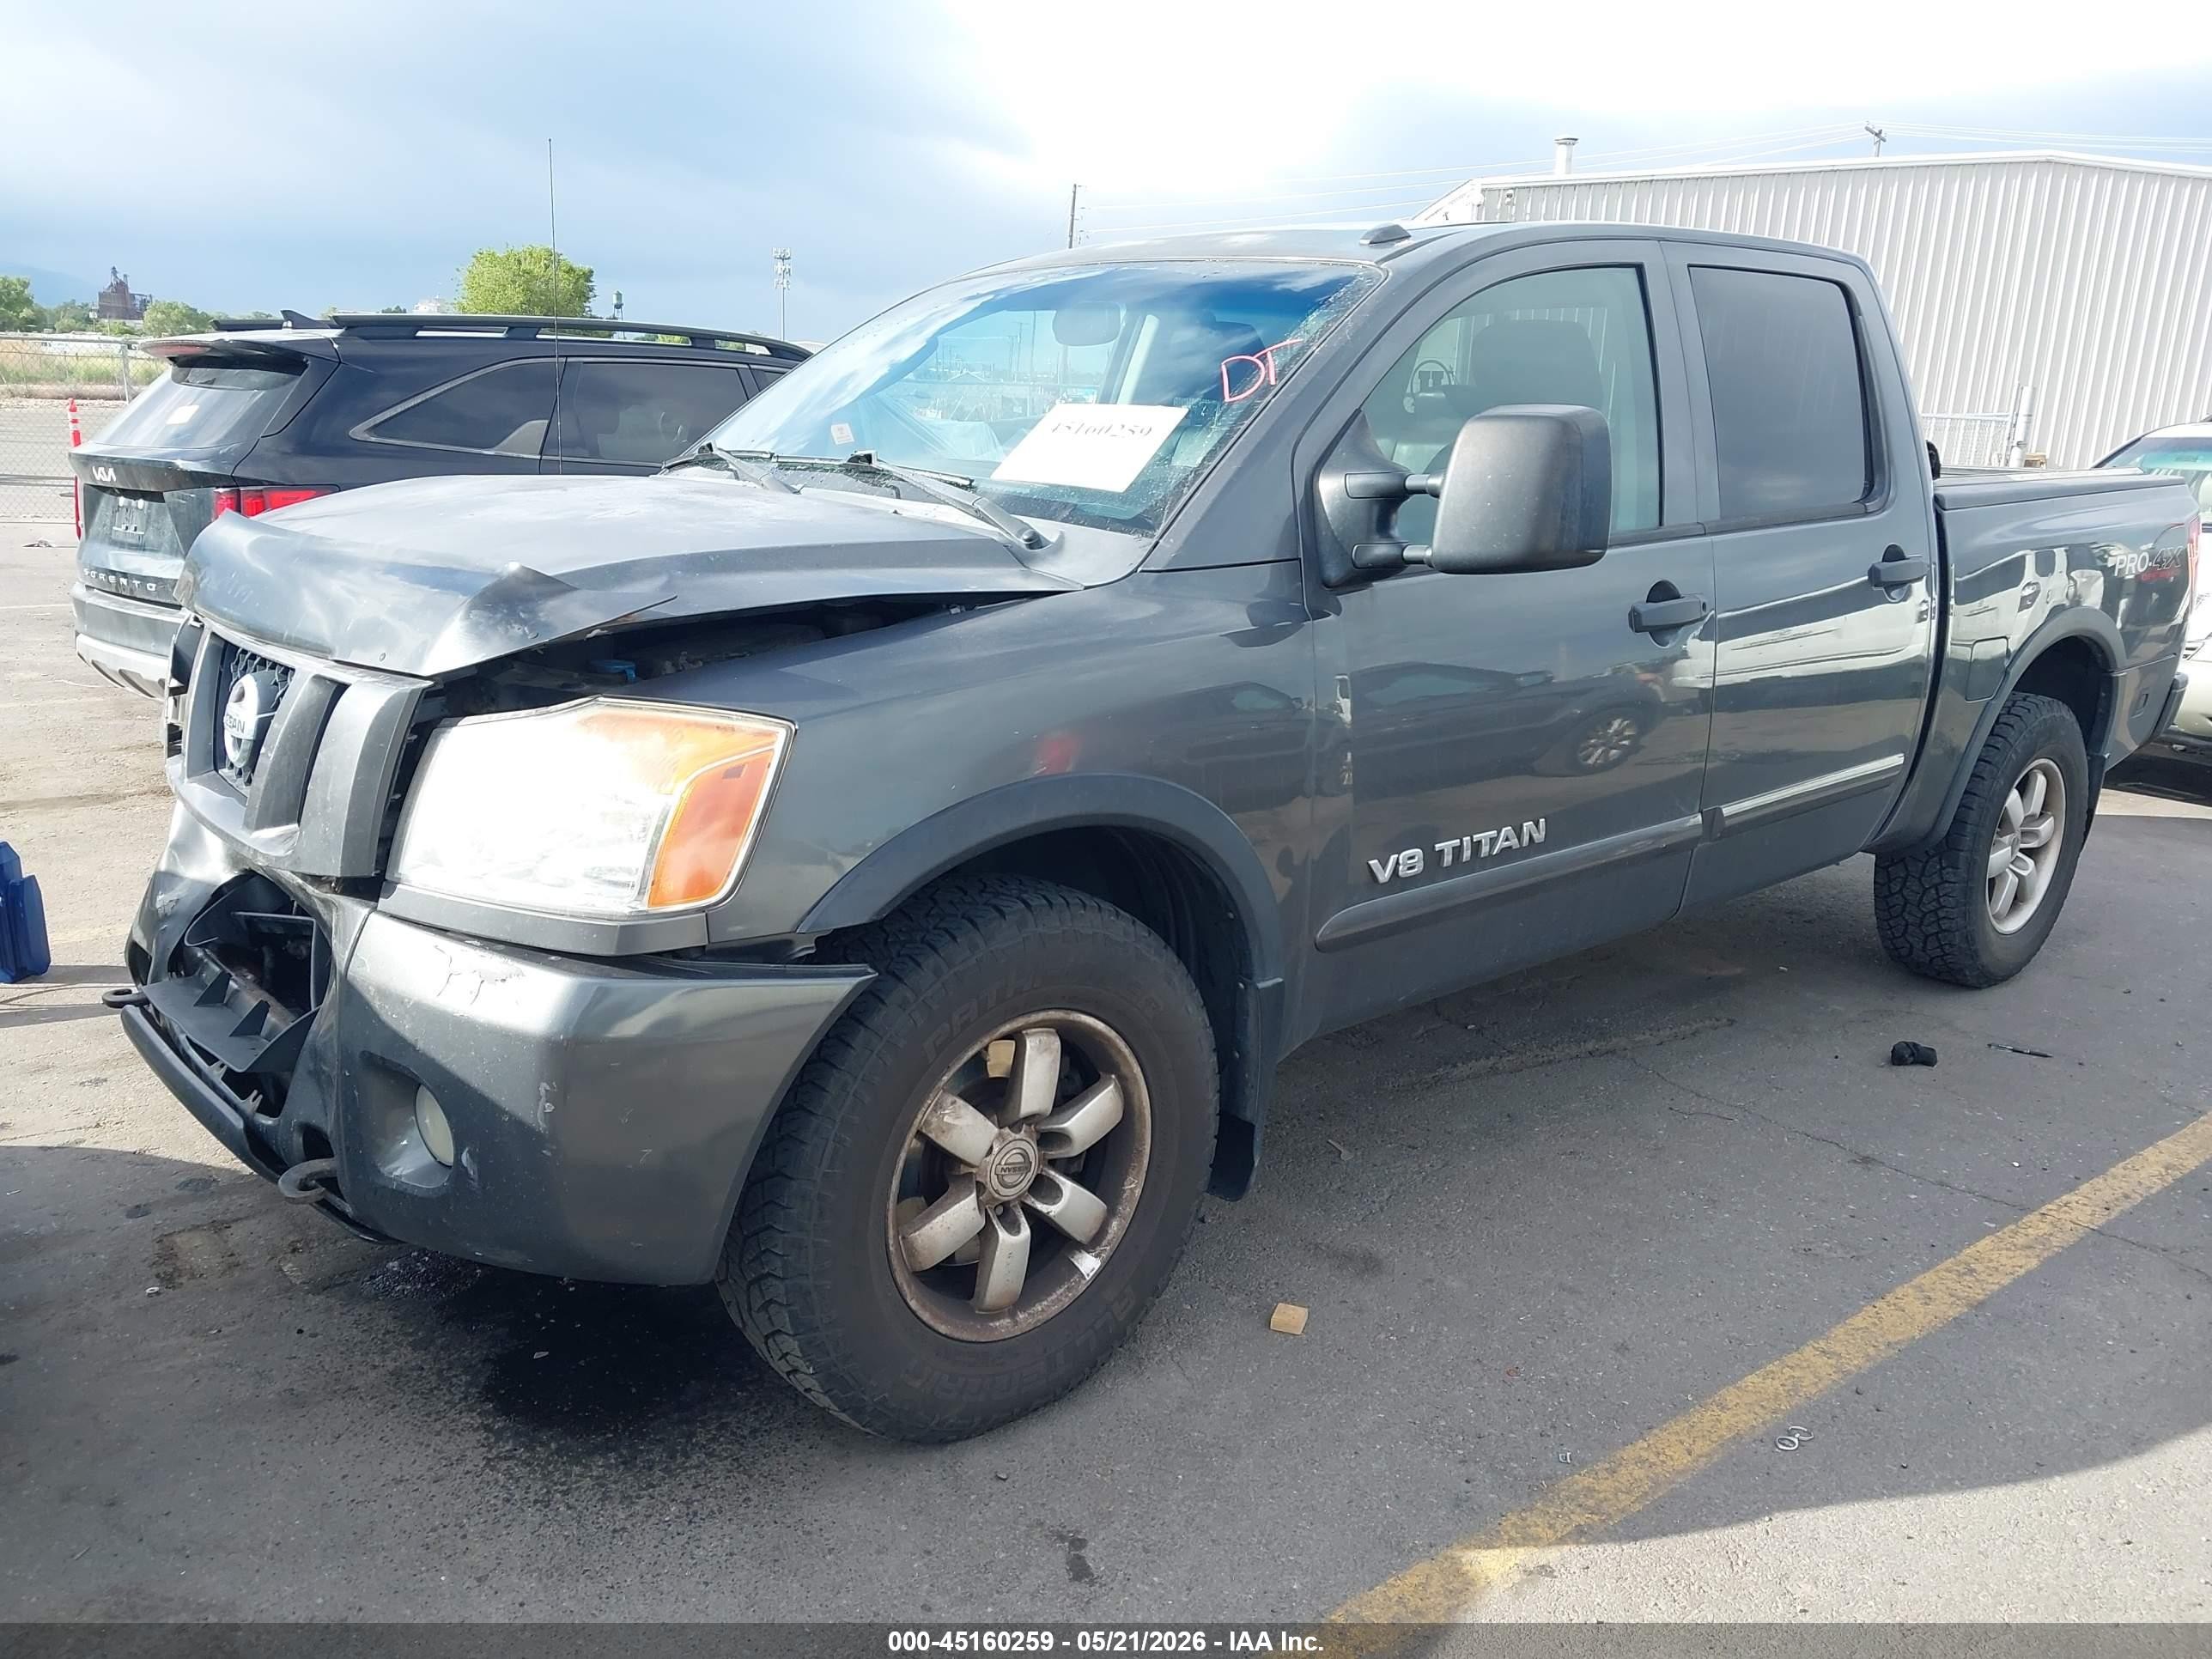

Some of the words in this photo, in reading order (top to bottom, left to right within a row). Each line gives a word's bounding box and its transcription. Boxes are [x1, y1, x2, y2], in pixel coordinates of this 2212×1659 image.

[83, 568, 157, 592] SORENTO
[1367, 848, 1425, 884] V8
[1433, 818, 1546, 868] TITAN
